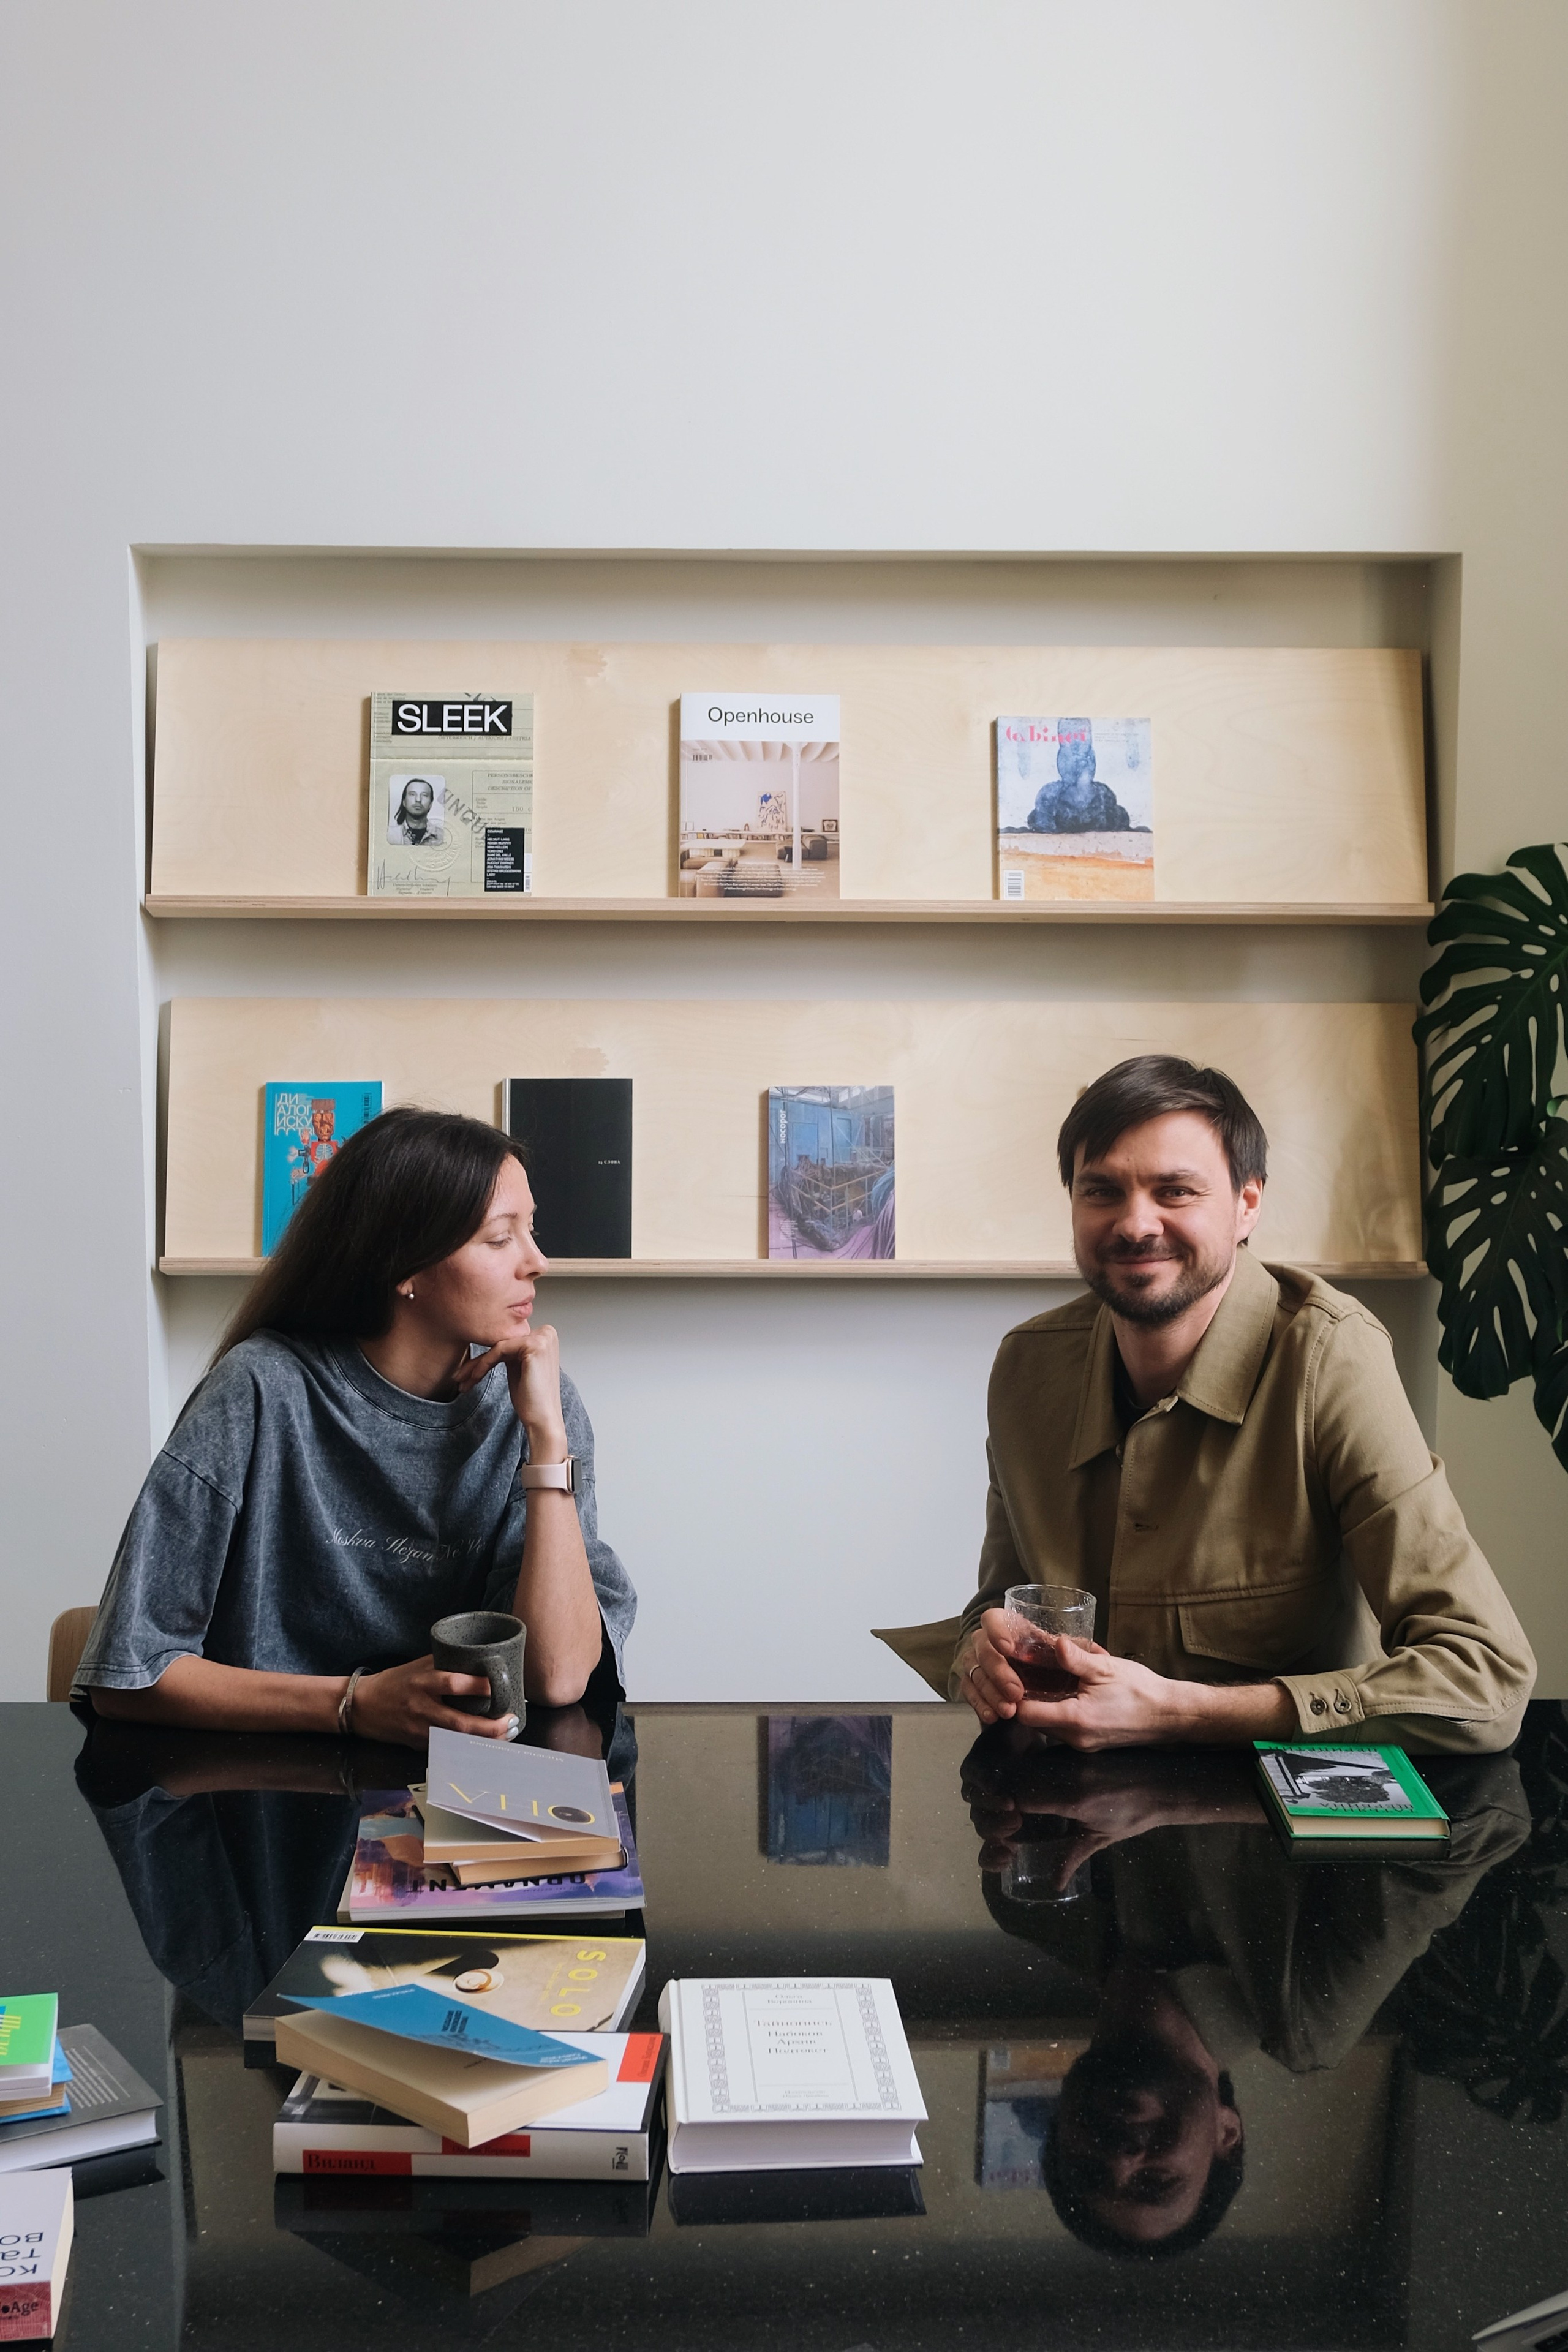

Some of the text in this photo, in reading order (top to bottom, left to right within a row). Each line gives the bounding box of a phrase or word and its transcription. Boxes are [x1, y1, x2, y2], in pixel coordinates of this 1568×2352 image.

[397, 704, 508, 733] SLEEK
[707, 707, 814, 726] Openhouse
[277, 1093, 298, 1107] ДИ
[277, 1105, 312, 1116] АЛОГ
[277, 1116, 312, 1127] ИСКУ
[325, 1528, 376, 1548] Moskva
[550, 1950, 606, 2017] SOLO
[308, 2154, 377, 2171] Виланд
